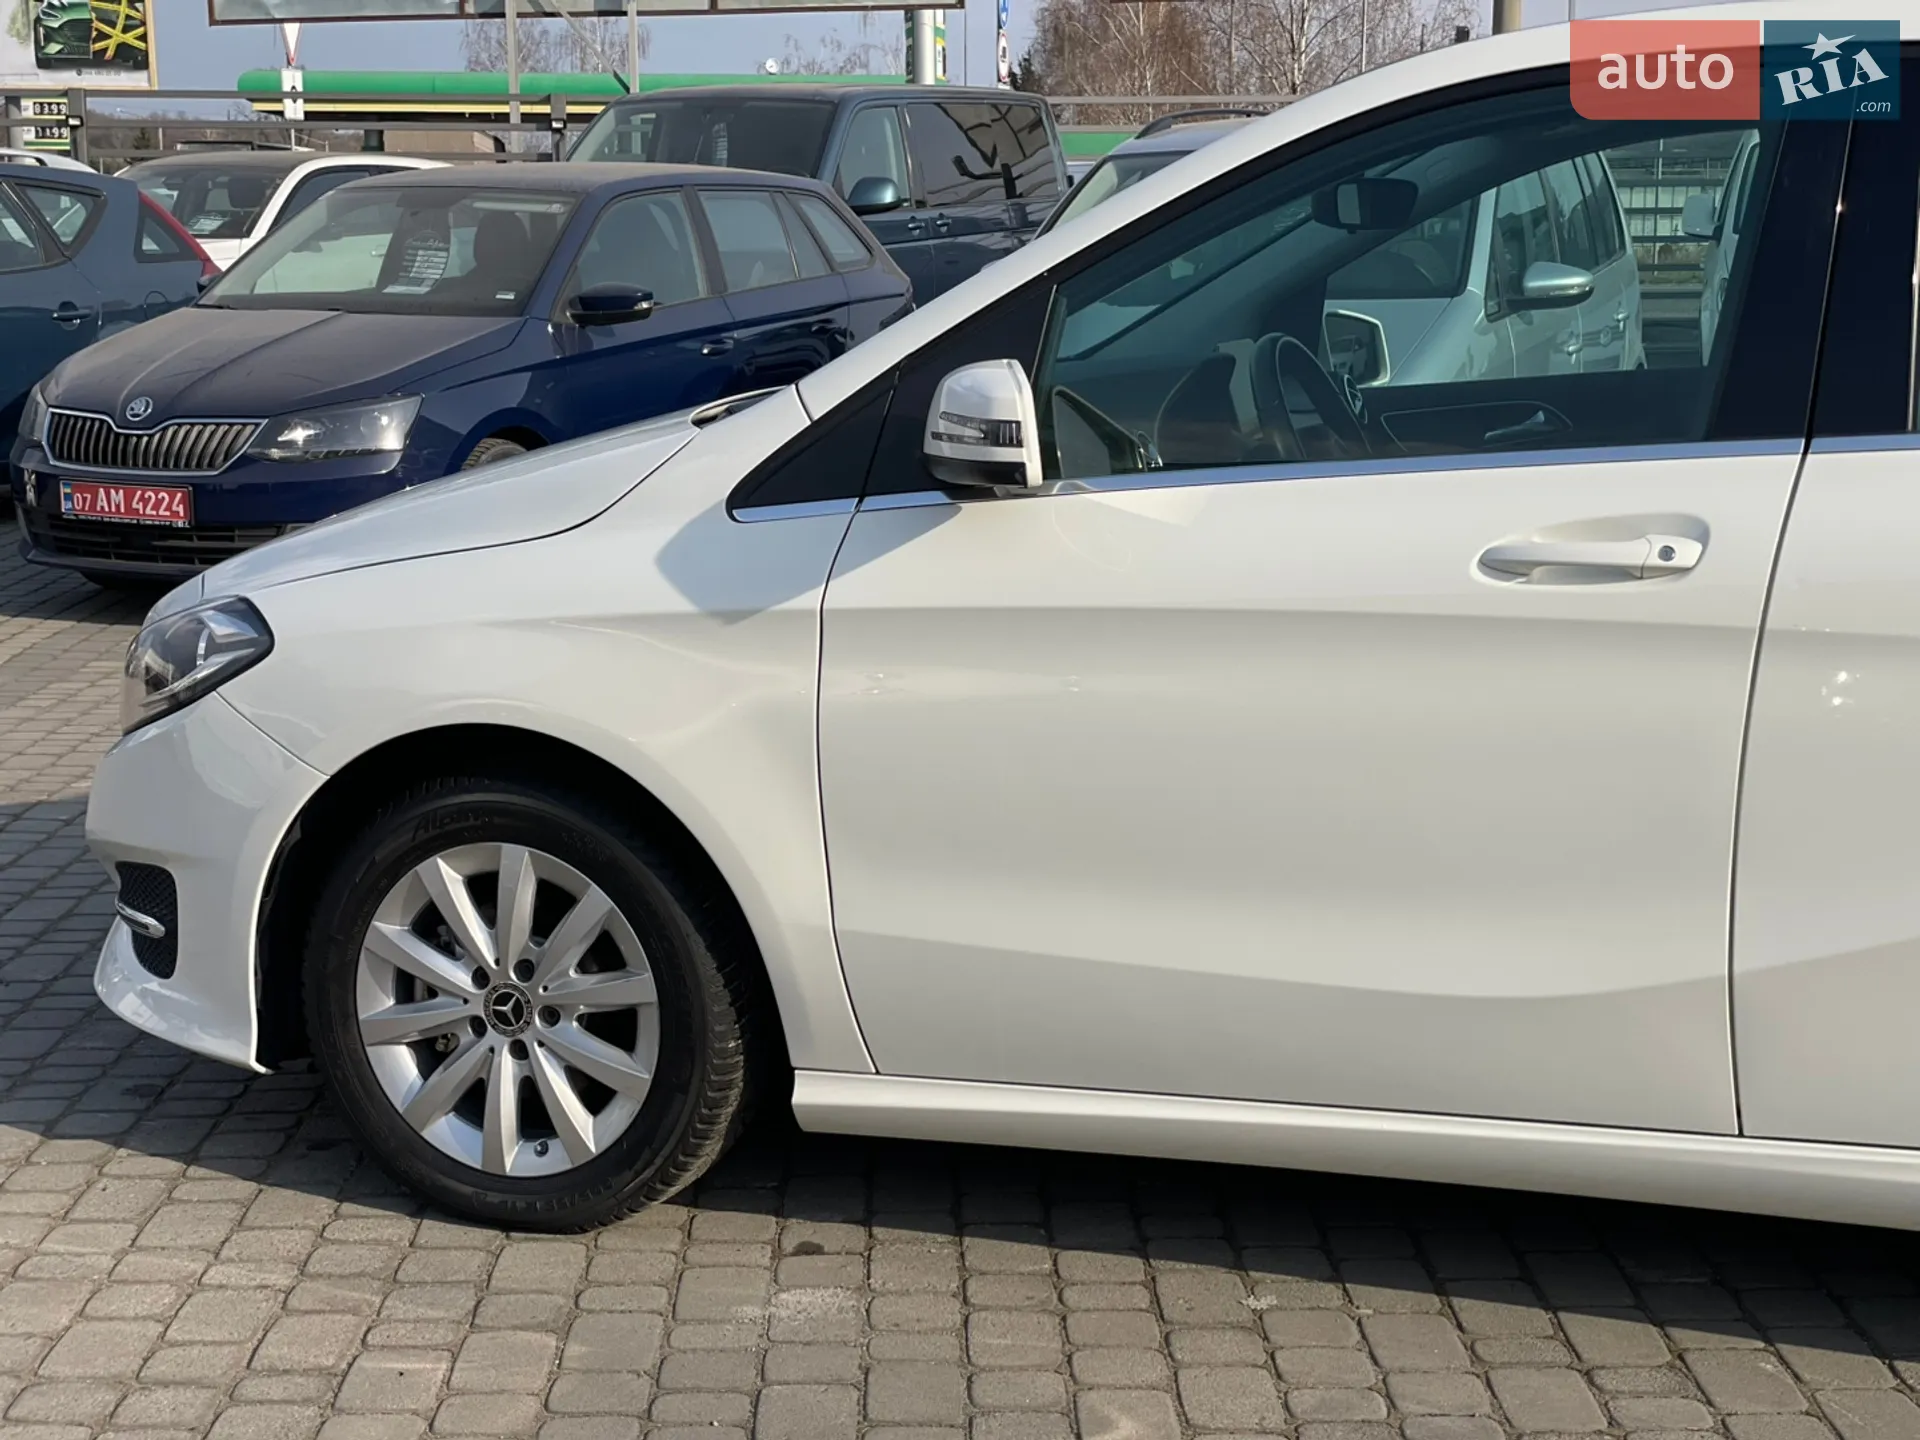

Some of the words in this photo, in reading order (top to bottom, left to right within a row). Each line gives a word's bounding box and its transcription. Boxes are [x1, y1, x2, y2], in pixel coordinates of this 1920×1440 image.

[73, 492, 92, 512] 07
[96, 487, 126, 513] AM
[131, 490, 185, 518] 4224
